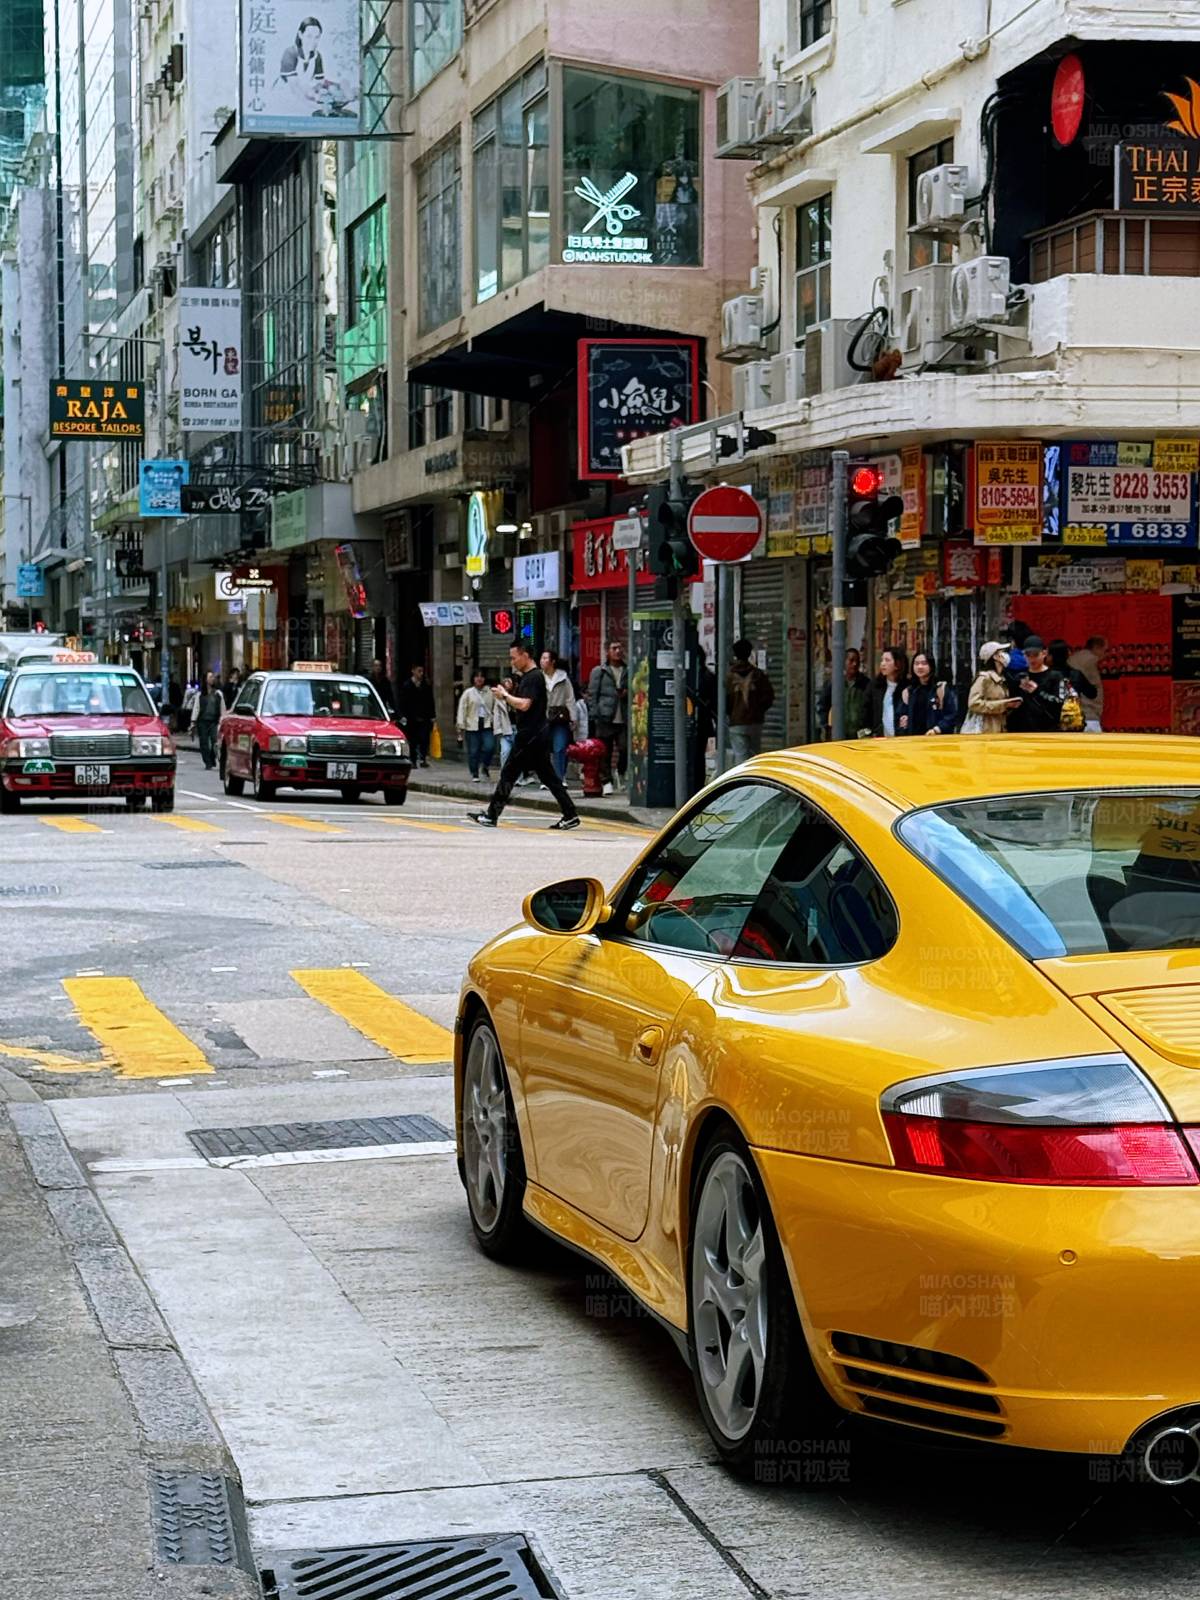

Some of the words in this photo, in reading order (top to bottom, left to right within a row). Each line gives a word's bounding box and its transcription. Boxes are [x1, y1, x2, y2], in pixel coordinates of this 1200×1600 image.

[247, 0, 277, 112] 庭僱傭中心
[1126, 146, 1188, 173] THAI
[182, 325, 222, 375] 본가
[183, 388, 217, 398] BORN
[221, 388, 238, 398] GA
[67, 400, 128, 422] RAJA
[53, 421, 97, 432] BESPOKE
[101, 423, 142, 434] TAILORS
[1071, 472, 1111, 496] 黎先生
[1113, 472, 1149, 499] 8228
[1152, 473, 1188, 500] 3553
[981, 487, 1037, 507] 8105-5694
[1131, 523, 1188, 538] 6833
[56, 653, 92, 662] TAXI
[85, 764, 101, 776] PN
